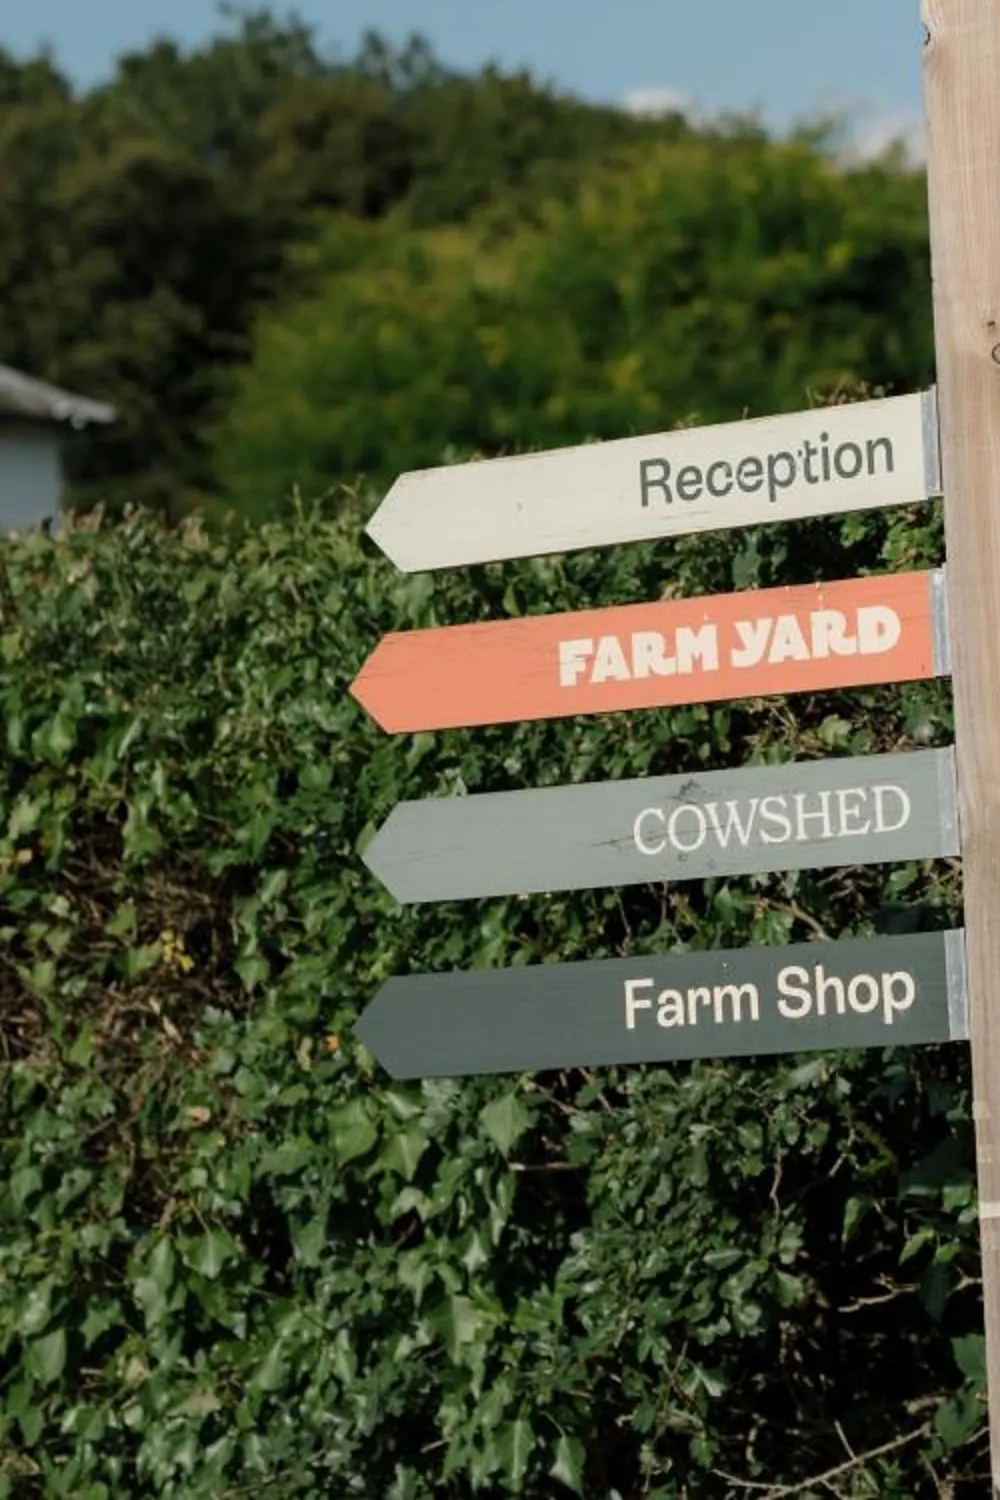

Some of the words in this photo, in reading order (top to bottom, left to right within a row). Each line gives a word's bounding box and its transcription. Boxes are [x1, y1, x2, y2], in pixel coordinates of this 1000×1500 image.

[640, 432, 894, 507] Reception
[559, 622, 718, 687] FARM
[730, 606, 901, 668] YARD
[633, 785, 910, 856] COWSHED
[625, 979, 759, 1030] Farm
[777, 964, 915, 1024] Shop
